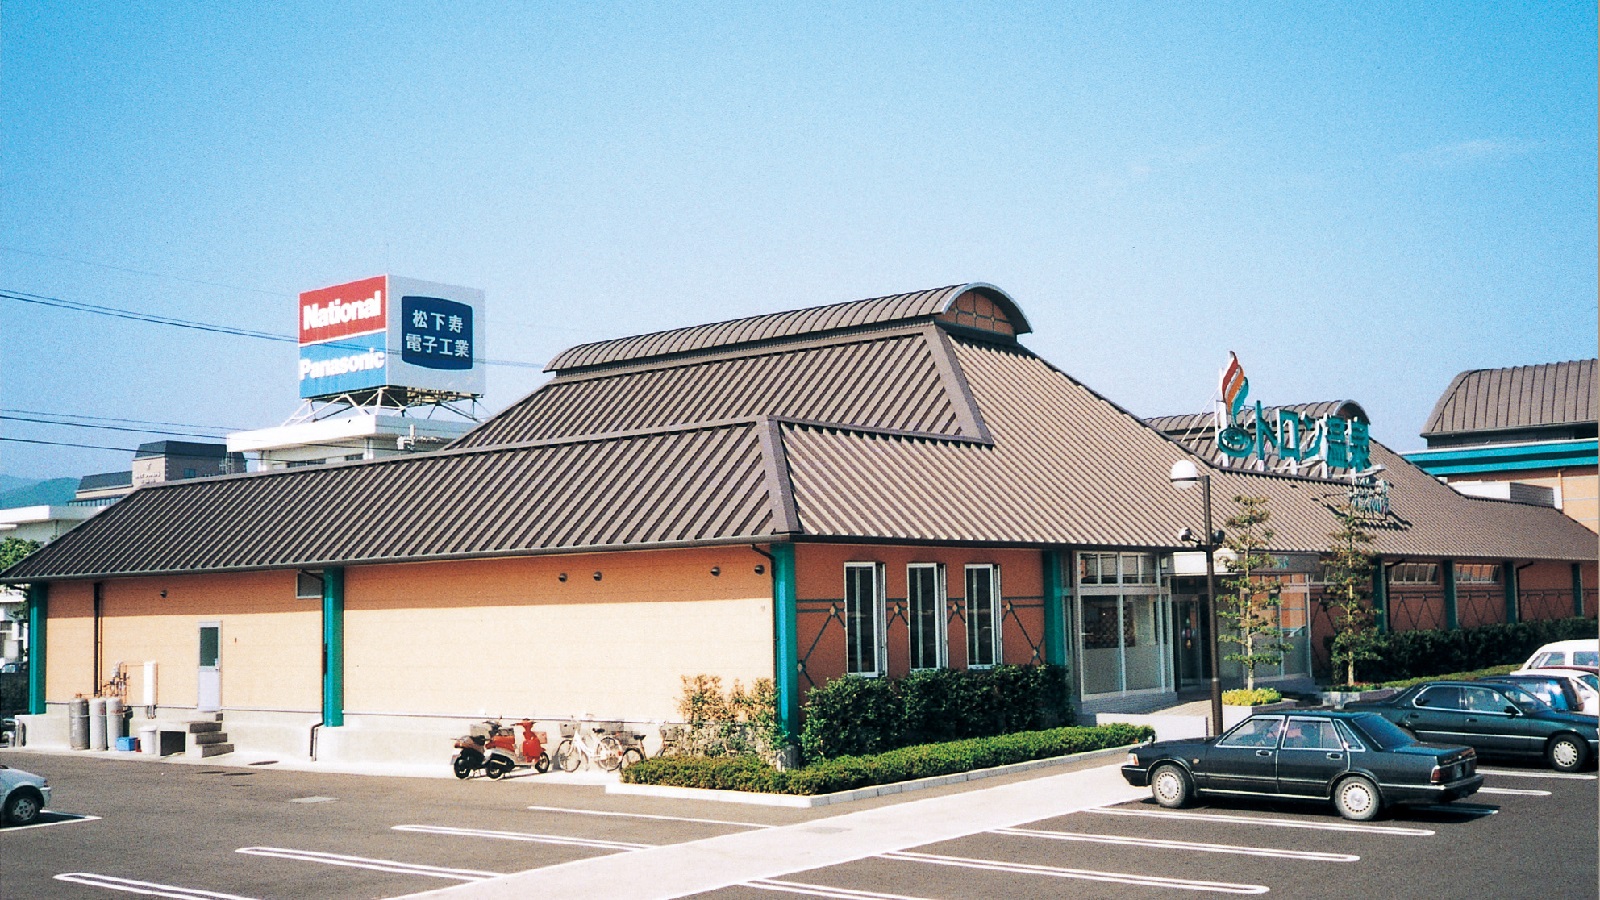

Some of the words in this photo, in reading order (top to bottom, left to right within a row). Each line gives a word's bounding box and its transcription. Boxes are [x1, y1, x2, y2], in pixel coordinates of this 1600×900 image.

[303, 290, 382, 331] National
[412, 309, 464, 334] 松下寿
[405, 333, 470, 358] 電子工業
[299, 347, 386, 381] Panasonic
